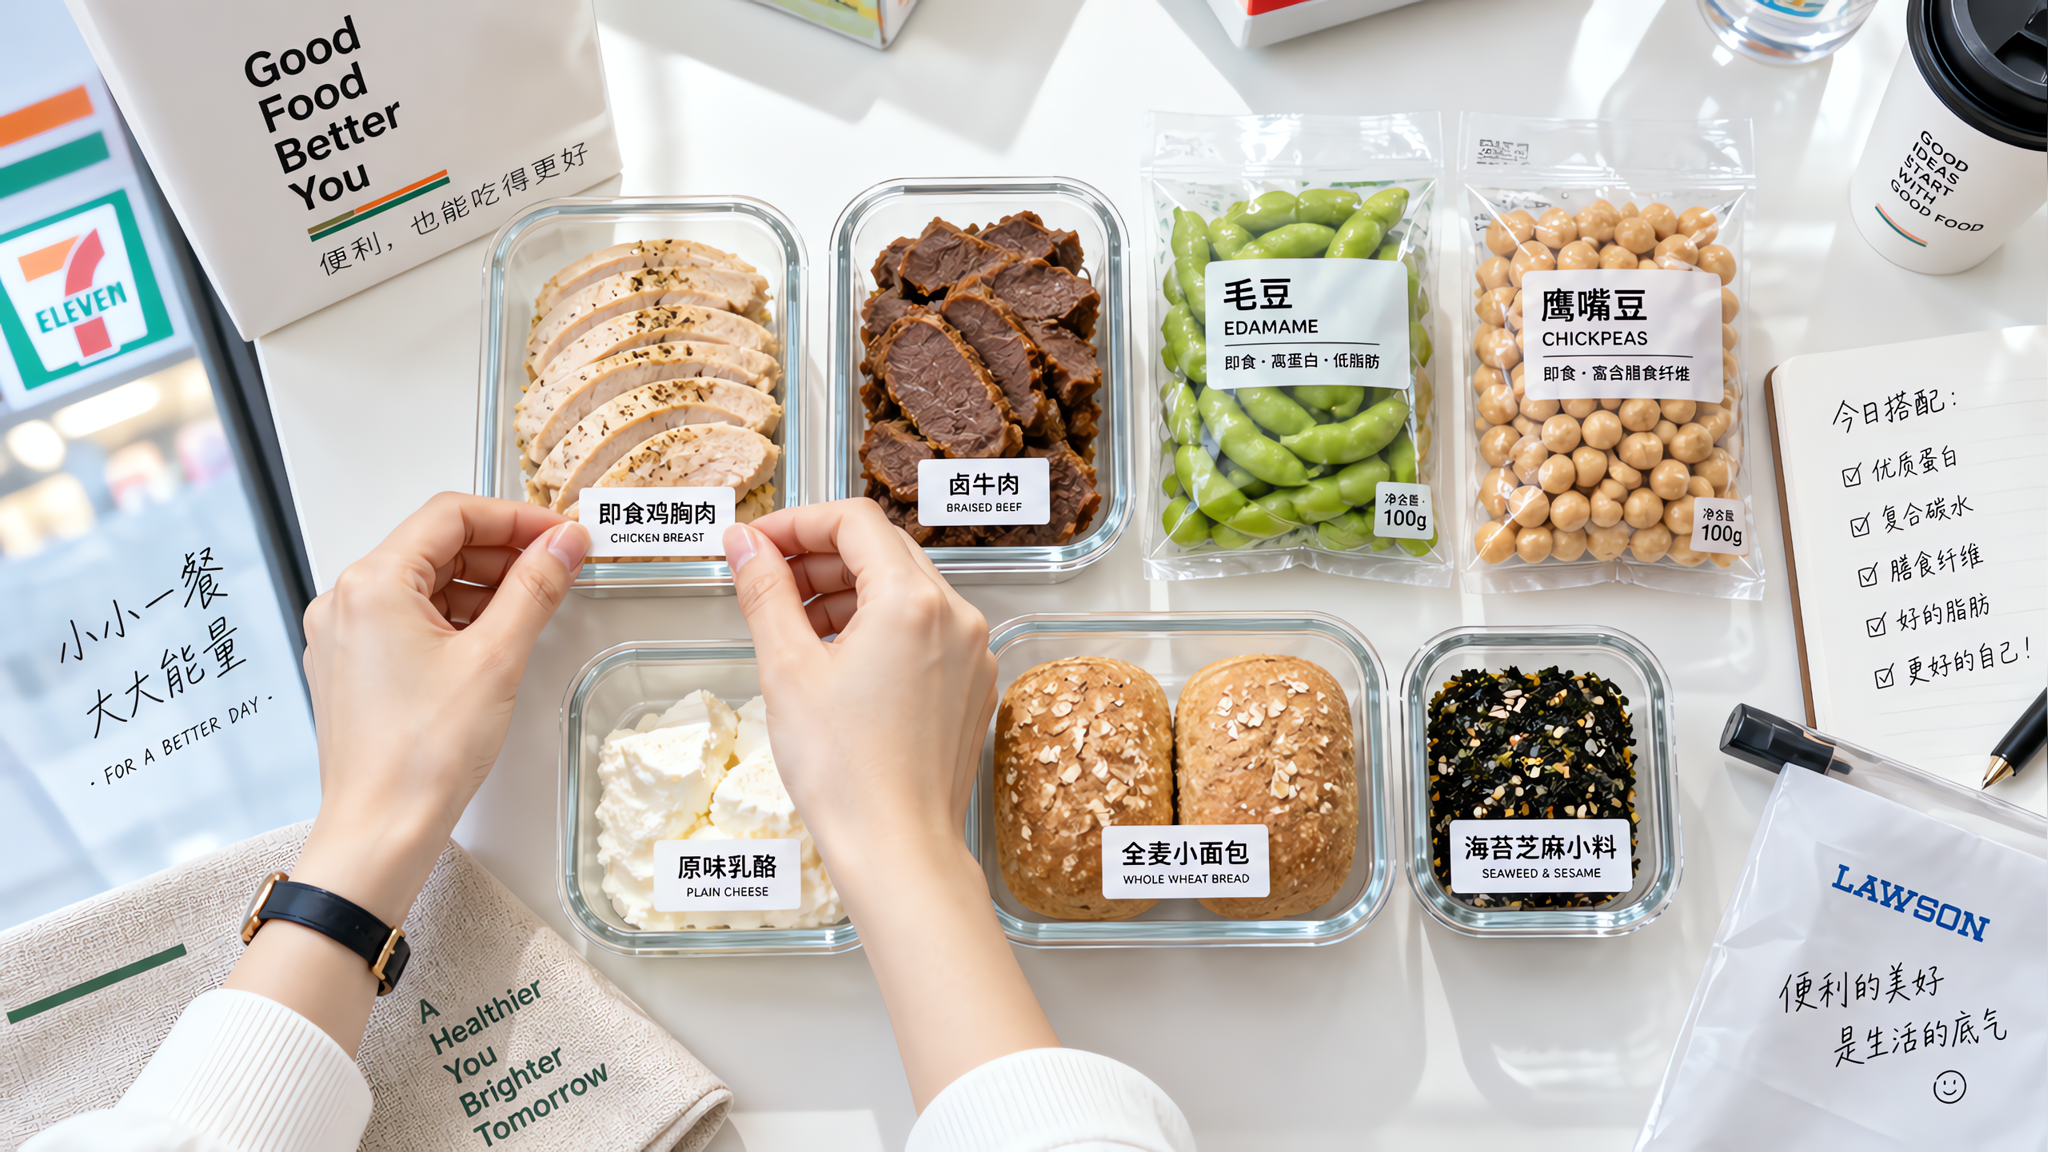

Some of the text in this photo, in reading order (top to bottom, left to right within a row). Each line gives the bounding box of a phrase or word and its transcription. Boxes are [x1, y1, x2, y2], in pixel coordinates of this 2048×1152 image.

[245, 15, 361, 88] Good
[259, 63, 368, 133] Food
[275, 101, 401, 175] Better
[1920, 131, 1969, 172] GOOD
[1904, 154, 1954, 196] START
[1912, 142, 1960, 184] IDEAS
[288, 164, 370, 211] You
[1890, 179, 1984, 232] GOOD FOOD
[1899, 167, 1937, 205] WITH
[319, 142, 588, 277] 便利，也能吃得更好
[1223, 277, 1293, 311] 毛豆
[1541, 287, 1648, 323] 鹰嘴豆
[1224, 319, 1319, 336] EDAMAME
[1542, 330, 1648, 347] CHICKPEAS
[1832, 388, 1957, 434] 今日搭配：
[1871, 445, 1957, 482] 优质蛋白
[949, 472, 1019, 496] 卤牛肉
[599, 500, 716, 526] 即食鸡胸肉
[946, 502, 1022, 513] BRAISED BEEF
[1384, 509, 1427, 531] 100g
[1882, 494, 1974, 534] 复合碳水
[610, 532, 705, 544] CHICKEN BREAST
[1701, 523, 1742, 547] 100g
[1890, 542, 1984, 583] 膳食纤维
[61, 547, 228, 663] 小小一餐
[1896, 592, 1990, 632] 好的脂肪
[86, 616, 247, 739] 大大能量
[1907, 636, 2030, 686] 更好的自己！
[104, 696, 258, 785] FOR A BETTER DAY
[678, 853, 777, 880] 原味乳酪
[1121, 839, 1250, 866] 全麦小面包
[1464, 834, 1617, 861] 海苔芝麻小料
[686, 886, 769, 898] PLAIN CHEESE
[1123, 873, 1250, 885] WHOLE WHEAT BREAD
[1482, 867, 1601, 879] SEAWEED & SESAME
[1831, 863, 1991, 943] LAWSON
[1778, 961, 1945, 1014] 便利的美好
[420, 998, 441, 1025] A
[429, 979, 541, 1055] Healthier
[1834, 1008, 2008, 1068] 是生活的底气
[442, 1045, 498, 1084] You
[459, 1046, 562, 1118] Brighter
[473, 1062, 608, 1147] Tomorrow
